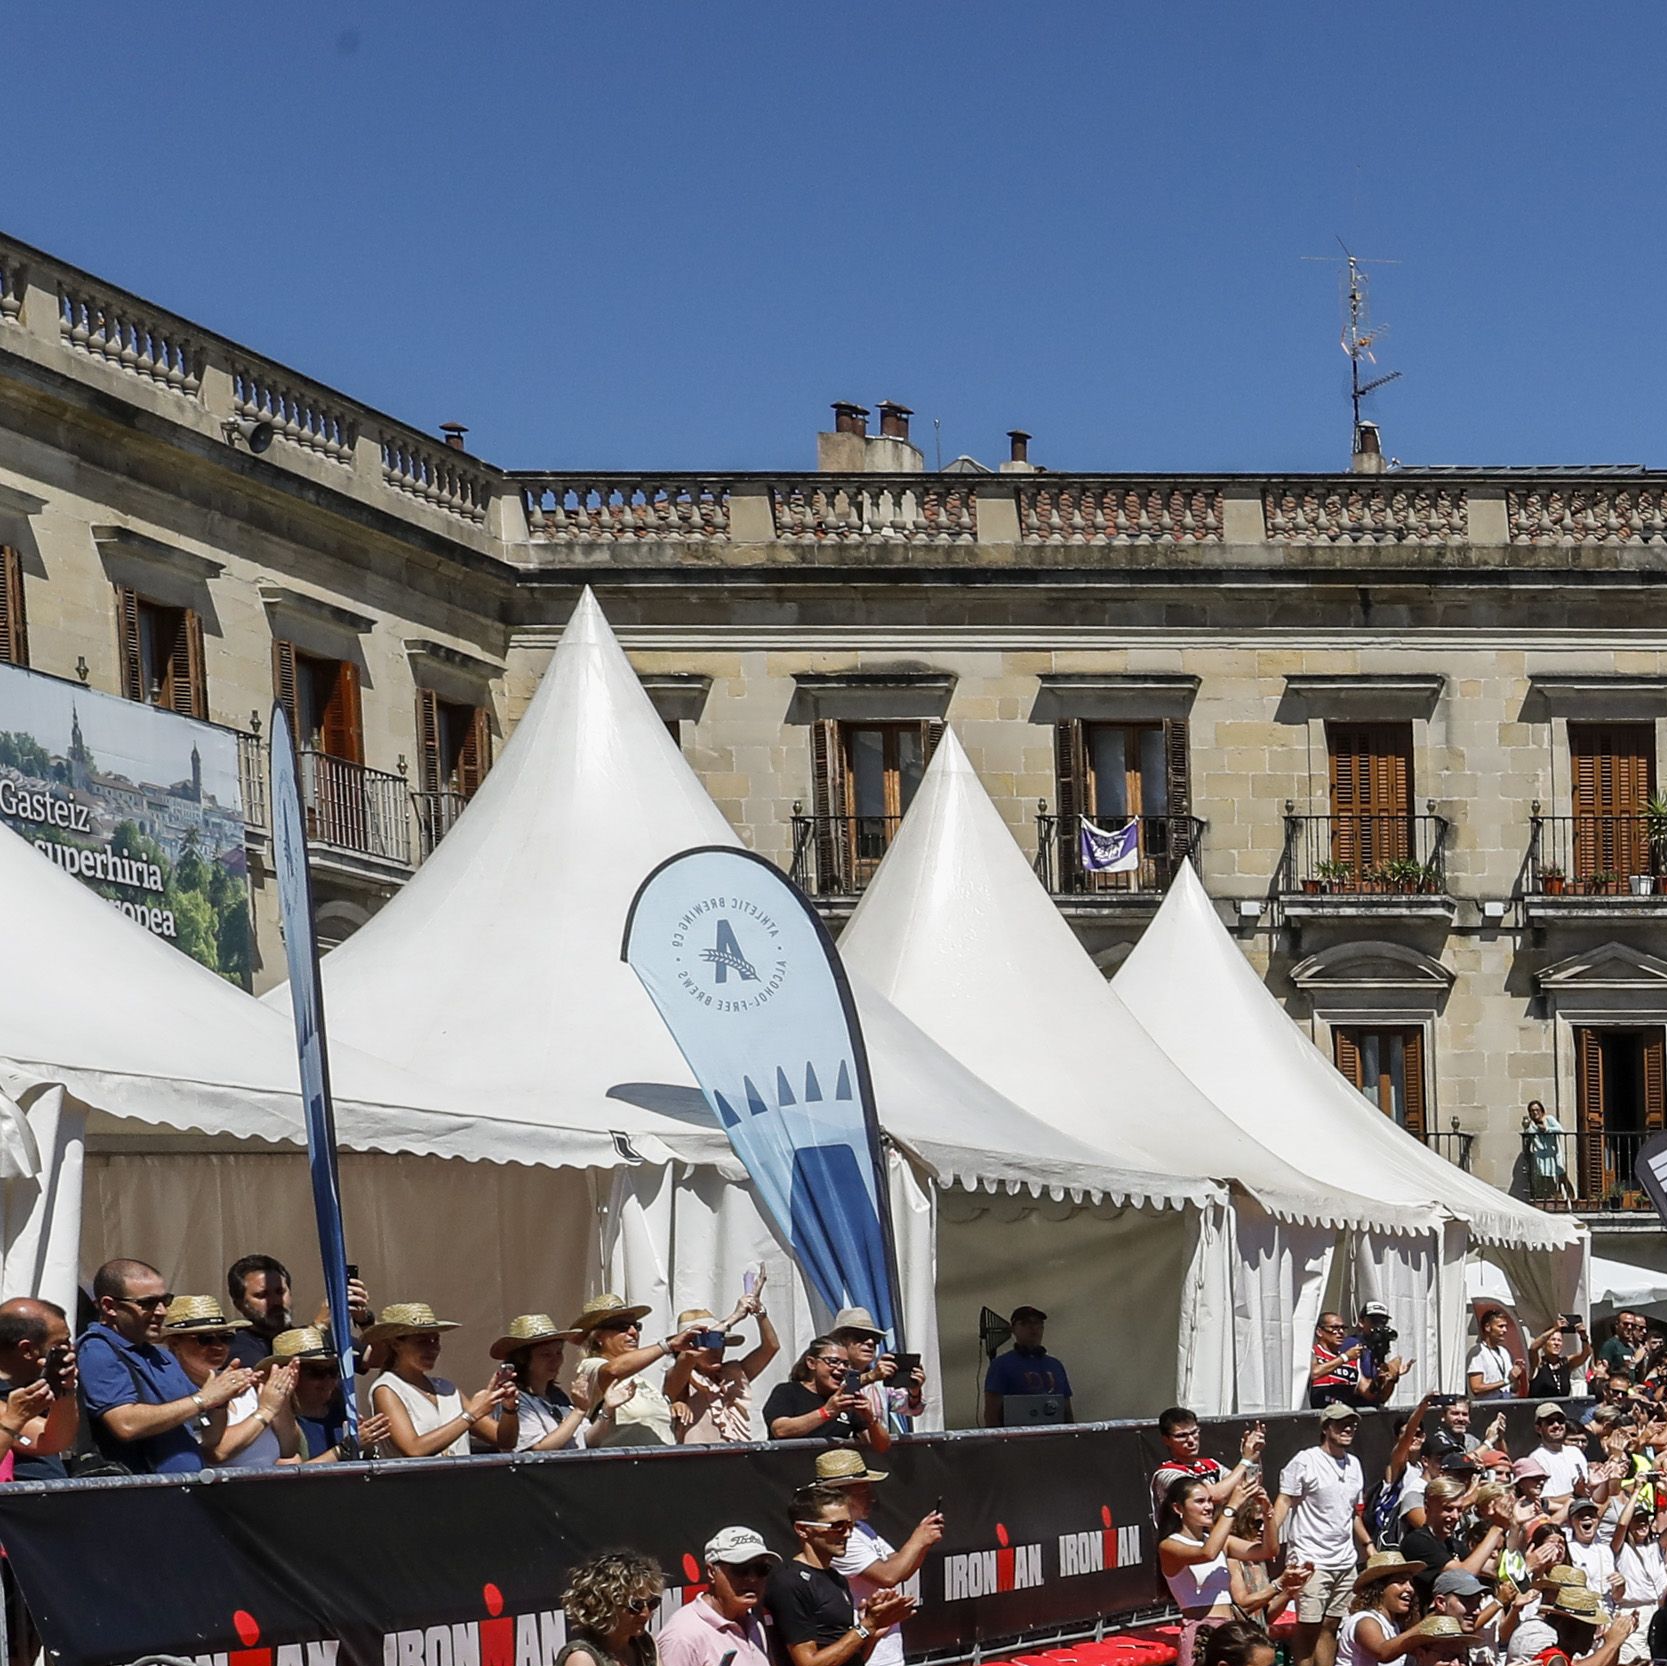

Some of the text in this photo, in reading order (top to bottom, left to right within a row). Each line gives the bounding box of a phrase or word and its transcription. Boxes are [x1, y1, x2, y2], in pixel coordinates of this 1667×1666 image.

[0, 780, 90, 832] Gasteiz
[944, 1523, 1044, 1601] IRONMAN
[1059, 1505, 1142, 1578] IRONMAN
